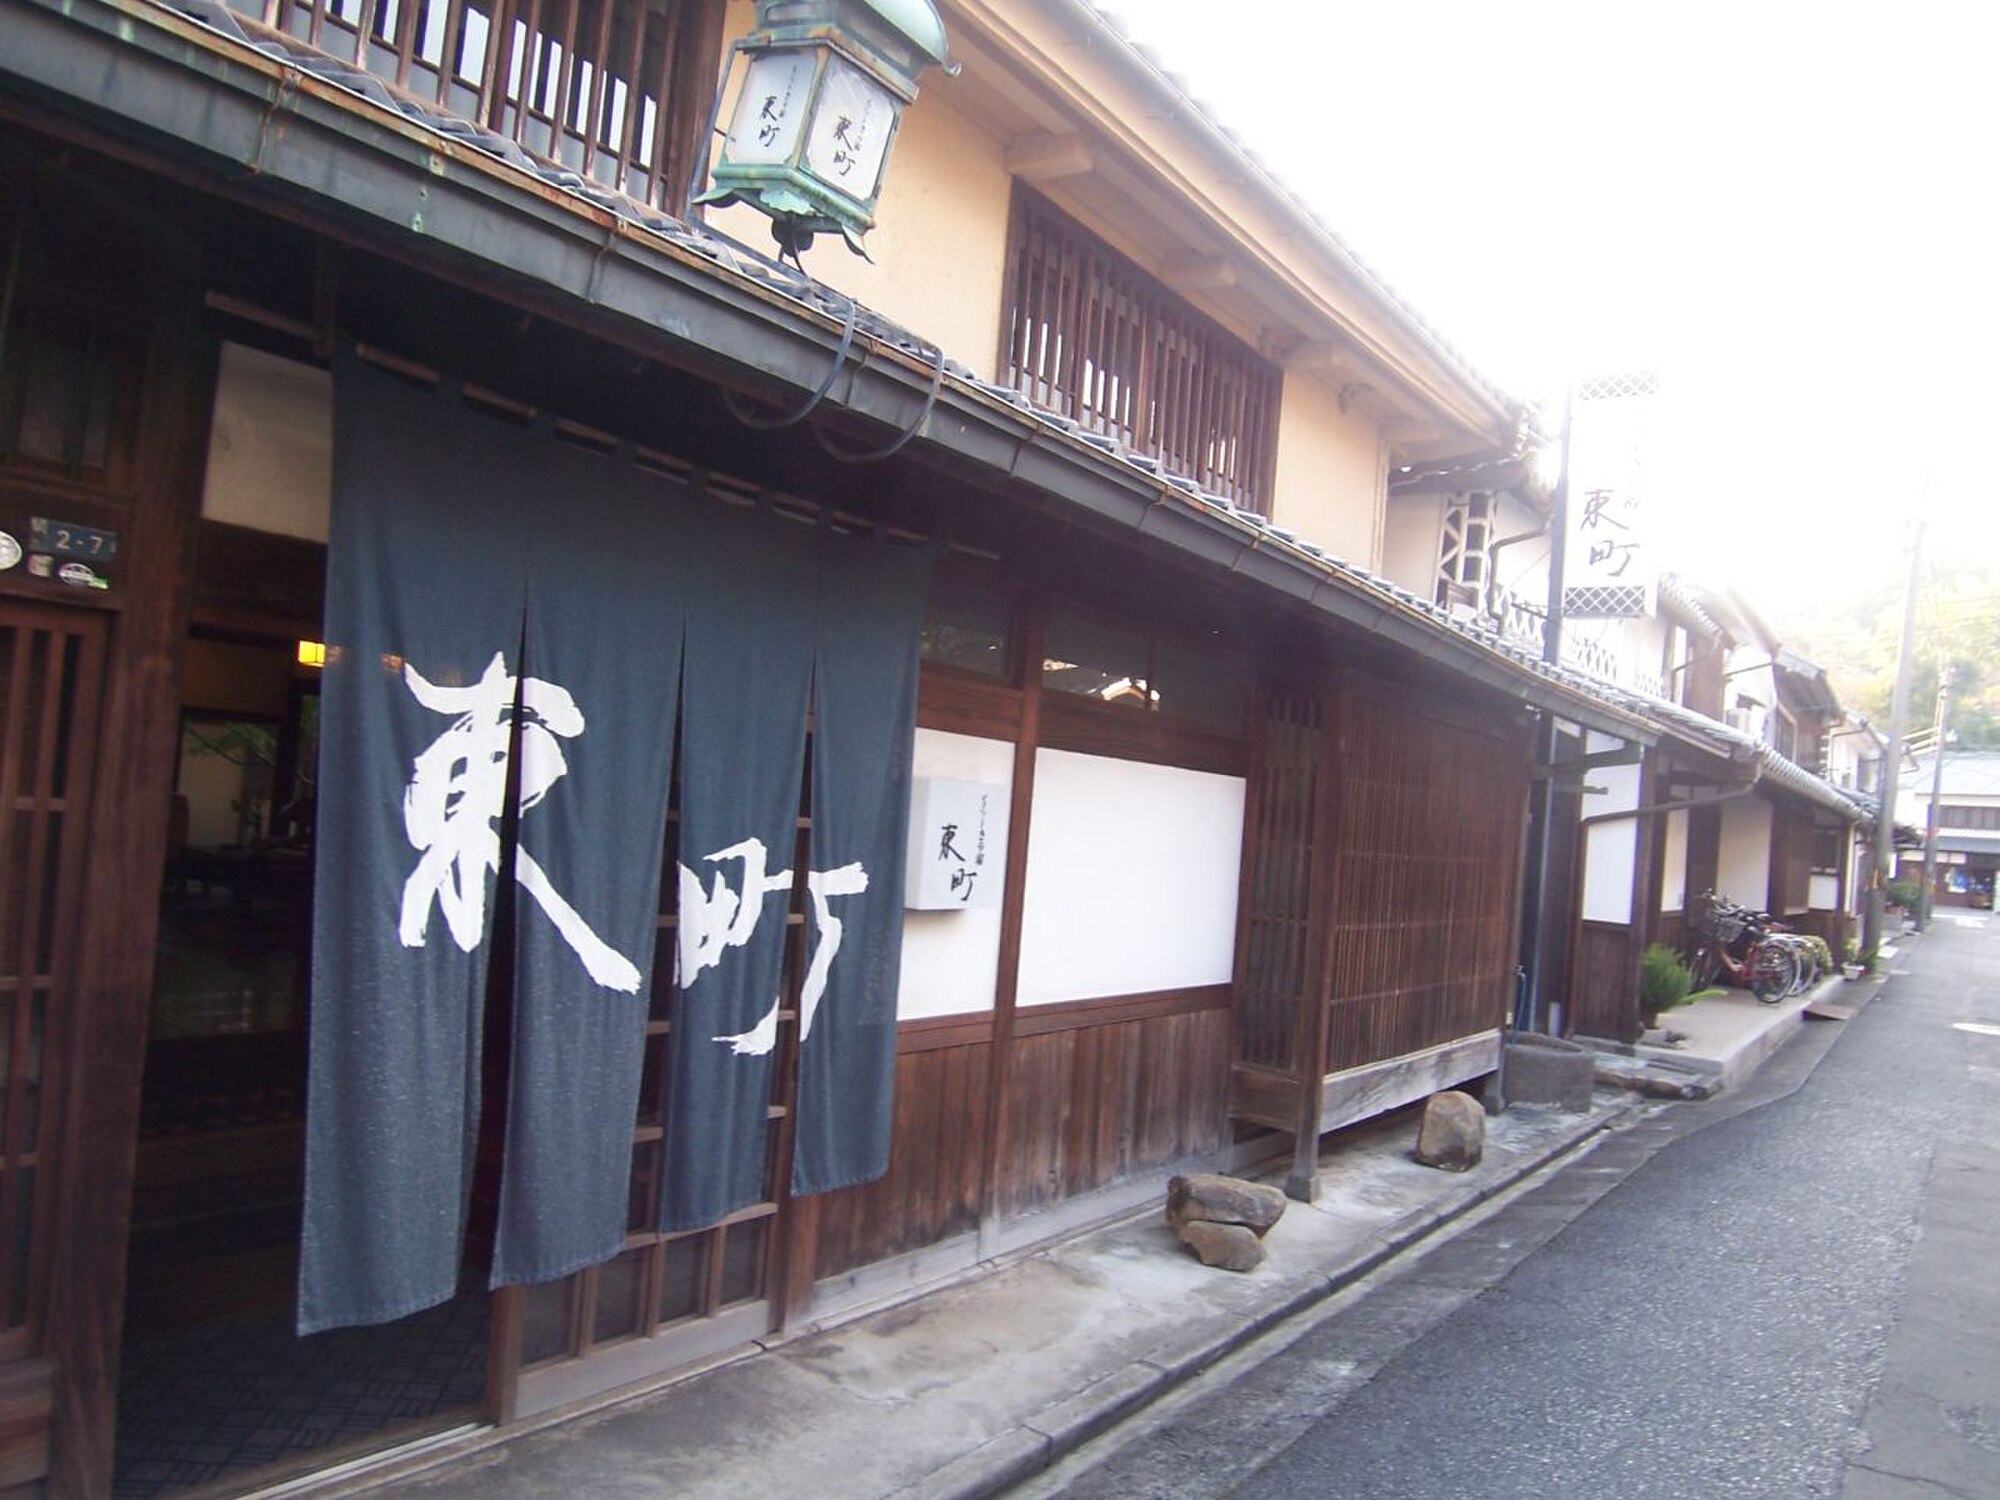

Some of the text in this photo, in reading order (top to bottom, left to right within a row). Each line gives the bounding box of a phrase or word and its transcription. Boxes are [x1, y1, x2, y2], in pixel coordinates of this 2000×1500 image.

[759, 95, 780, 147] 東町
[834, 115, 857, 176] 東町
[1580, 488, 1640, 577] 東町
[400, 651, 868, 1055] 東町
[938, 822, 978, 901] 東町
